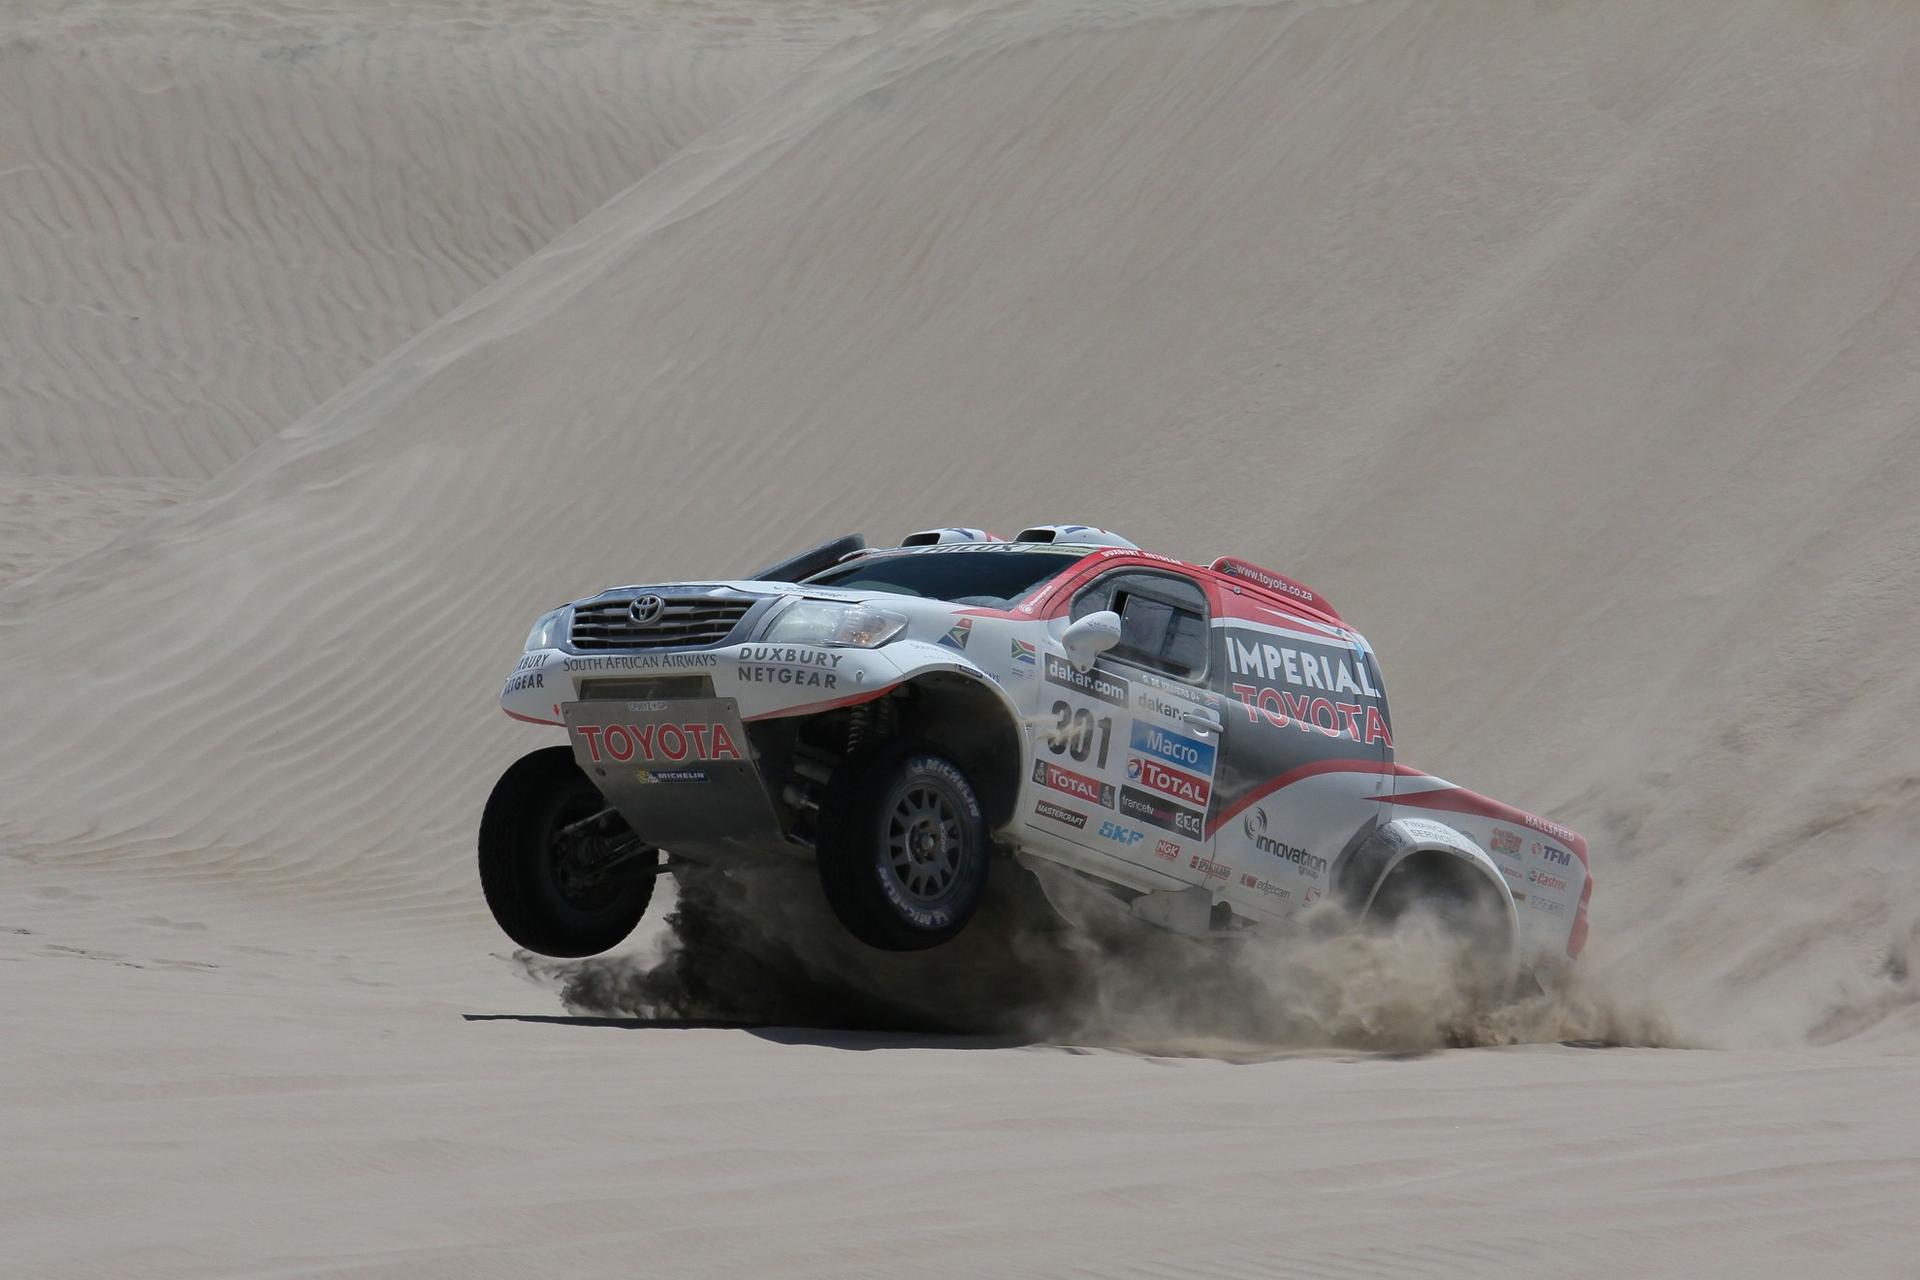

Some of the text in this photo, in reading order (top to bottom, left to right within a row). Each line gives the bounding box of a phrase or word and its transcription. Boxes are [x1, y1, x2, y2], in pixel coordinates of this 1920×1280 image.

[1236, 563, 1313, 601] www.toyota.co.za
[563, 653, 717, 672] SOUTH AFRICAN AIRWAYS
[738, 647, 844, 669] DUXBURY
[1225, 636, 1382, 698] IMPERIAL
[738, 667, 838, 690] NETGEAR
[1049, 660, 1125, 700] dakar.com
[1232, 682, 1394, 749] TOYOTA
[576, 722, 741, 762] TOYOTA
[1047, 700, 1113, 770] 301
[1147, 729, 1199, 765] Macro
[658, 771, 705, 781] MICHELIN
[1050, 768, 1098, 799] TOTAL
[1147, 763, 1206, 803] TOTAL
[1038, 804, 1085, 826] MASTERCRAFT
[1525, 815, 1575, 841] HALLSPEED
[1099, 821, 1145, 846] SKF
[1156, 841, 1179, 857] NGK
[1256, 834, 1328, 874] innovation
[1542, 845, 1572, 867] TFM
[1536, 872, 1567, 891] Castrol
